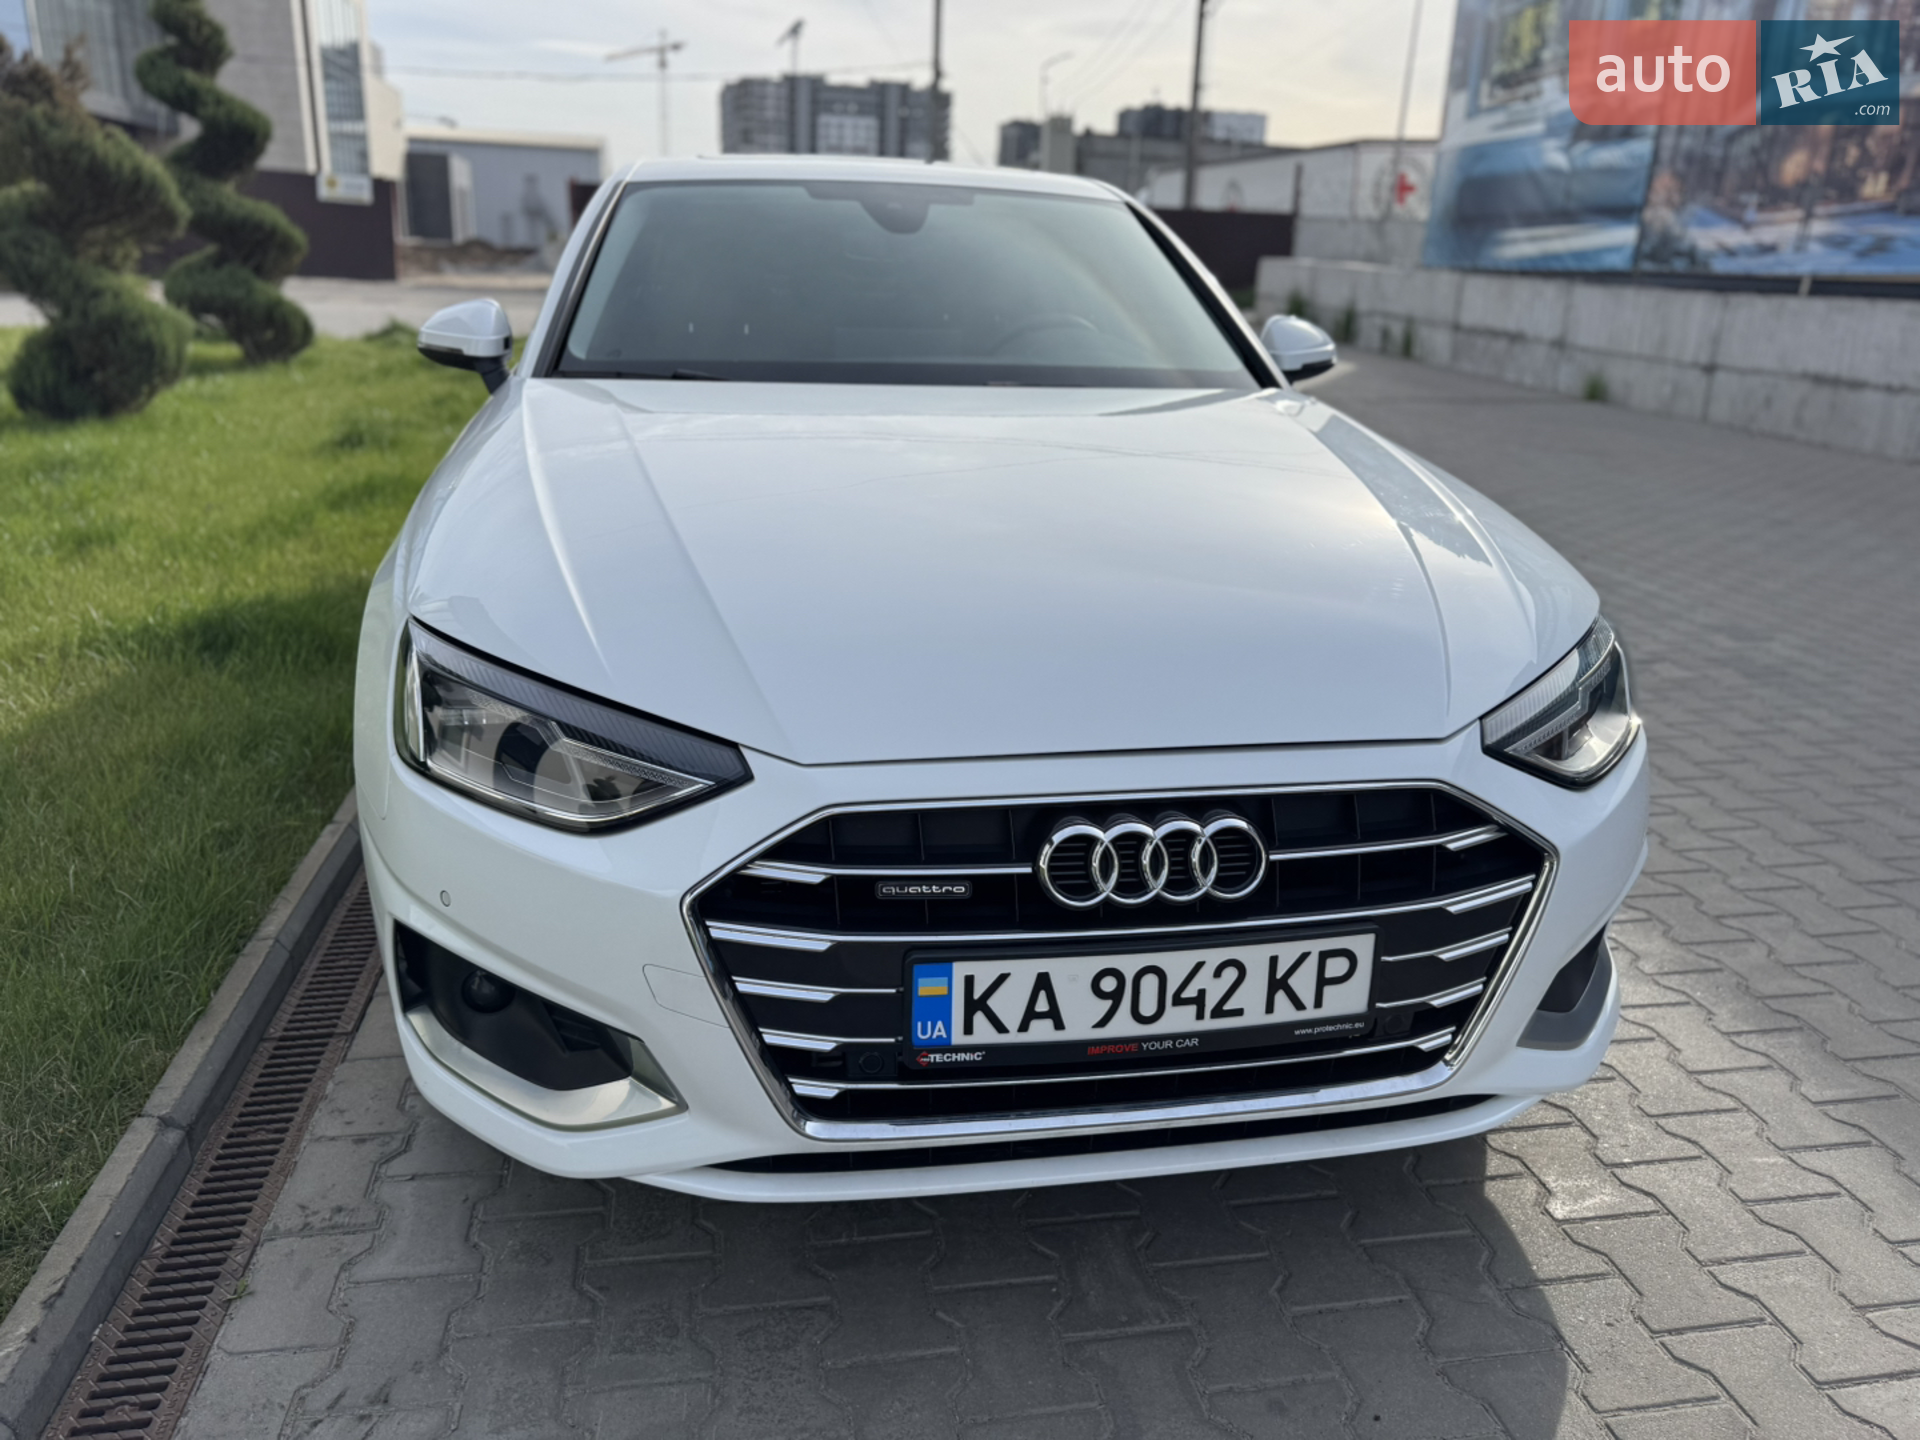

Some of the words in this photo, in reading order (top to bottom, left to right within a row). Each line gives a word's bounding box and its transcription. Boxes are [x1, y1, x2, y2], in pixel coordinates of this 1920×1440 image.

[882, 885, 965, 895] quattro
[962, 971, 1066, 1036] KA
[1090, 958, 1247, 1029] 9042
[1264, 947, 1358, 1014] KP
[916, 1020, 947, 1039] UA
[1294, 1021, 1365, 1035] www.protechnic.eu
[1087, 1042, 1138, 1055] IMPROVE
[1141, 1040, 1173, 1051] YOUR
[1175, 1038, 1199, 1048] CAR
